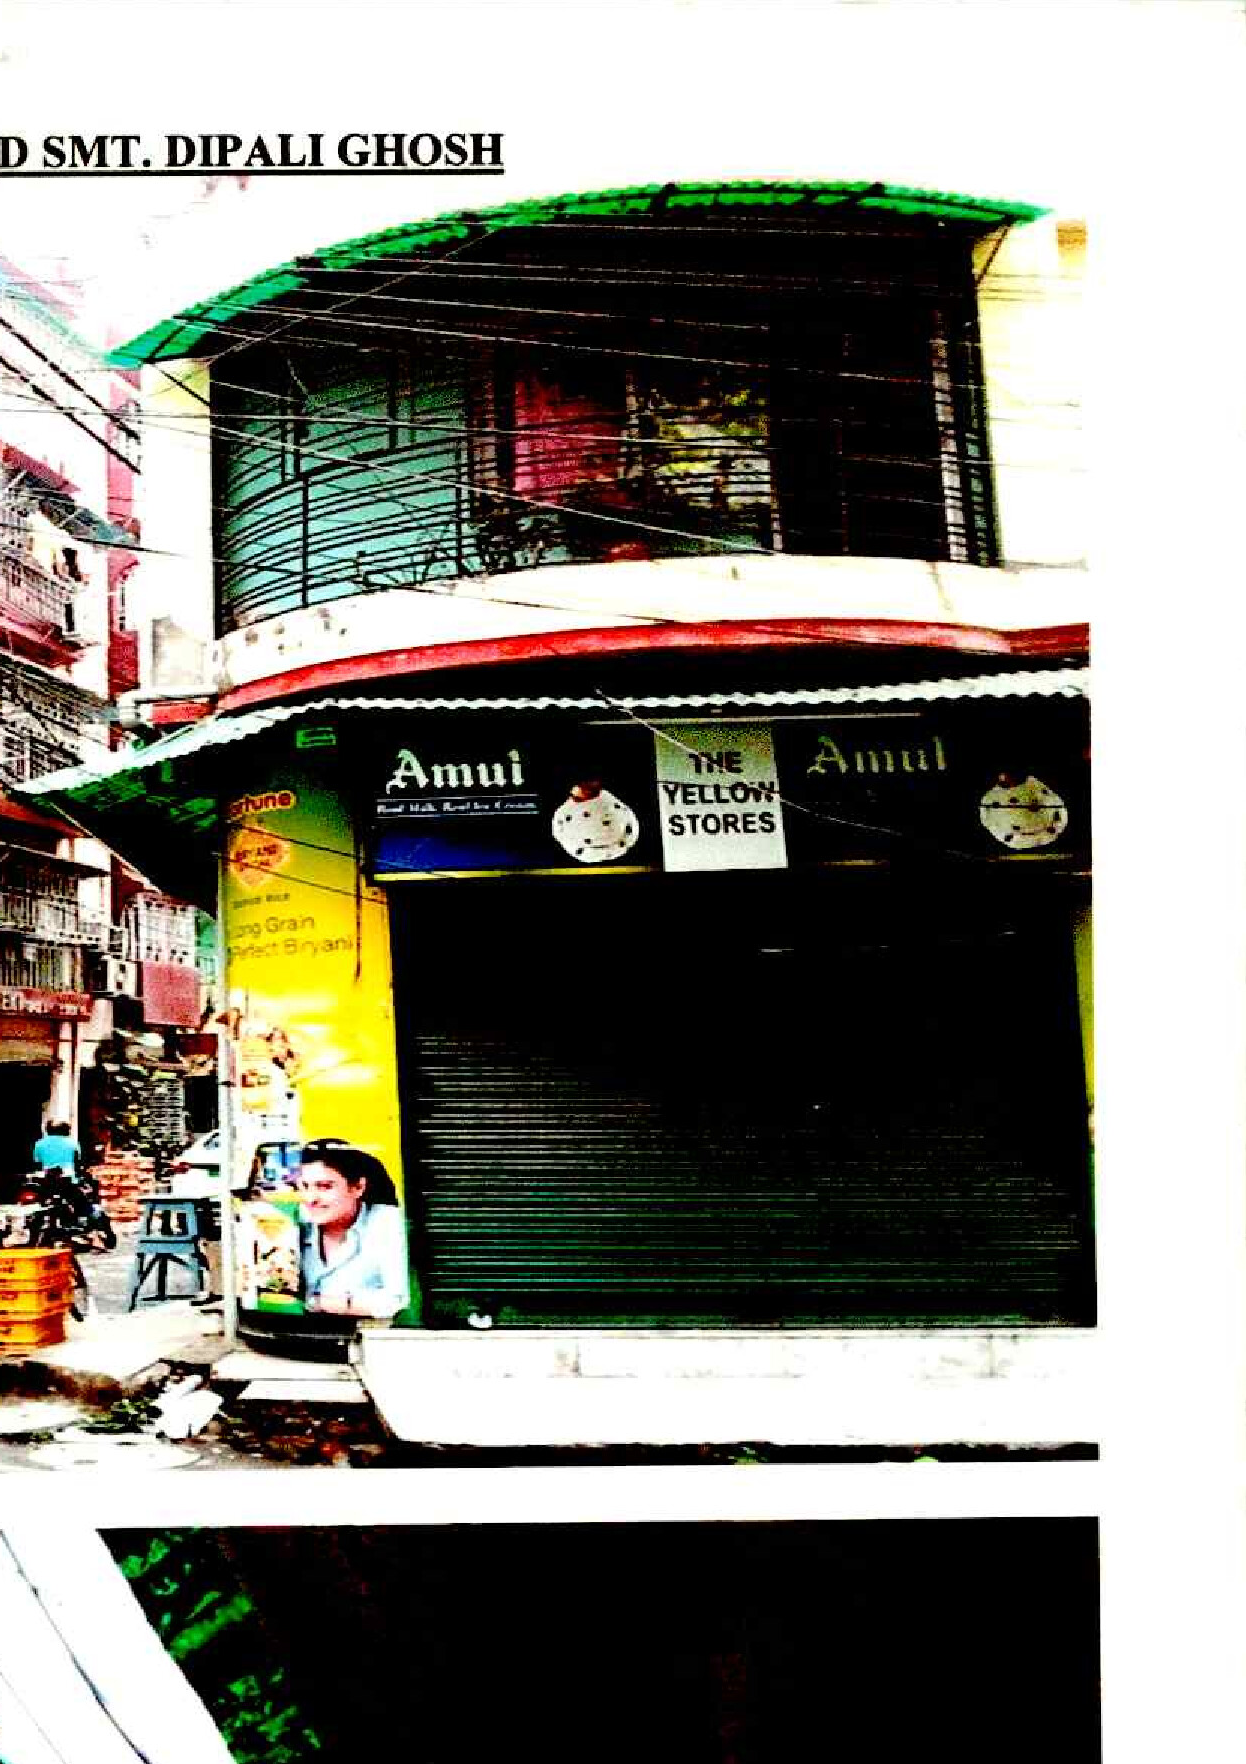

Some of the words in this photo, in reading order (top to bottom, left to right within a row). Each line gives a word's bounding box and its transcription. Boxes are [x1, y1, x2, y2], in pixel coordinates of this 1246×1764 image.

[44, 136, 150, 166] SMT.
[165, 134, 323, 165] DIPALI
[338, 134, 503, 164] GHOSH
[385, 748, 525, 795] Amul
[688, 750, 744, 774] THE
[662, 781, 777, 805] YELLOW
[668, 811, 776, 836] STORES
